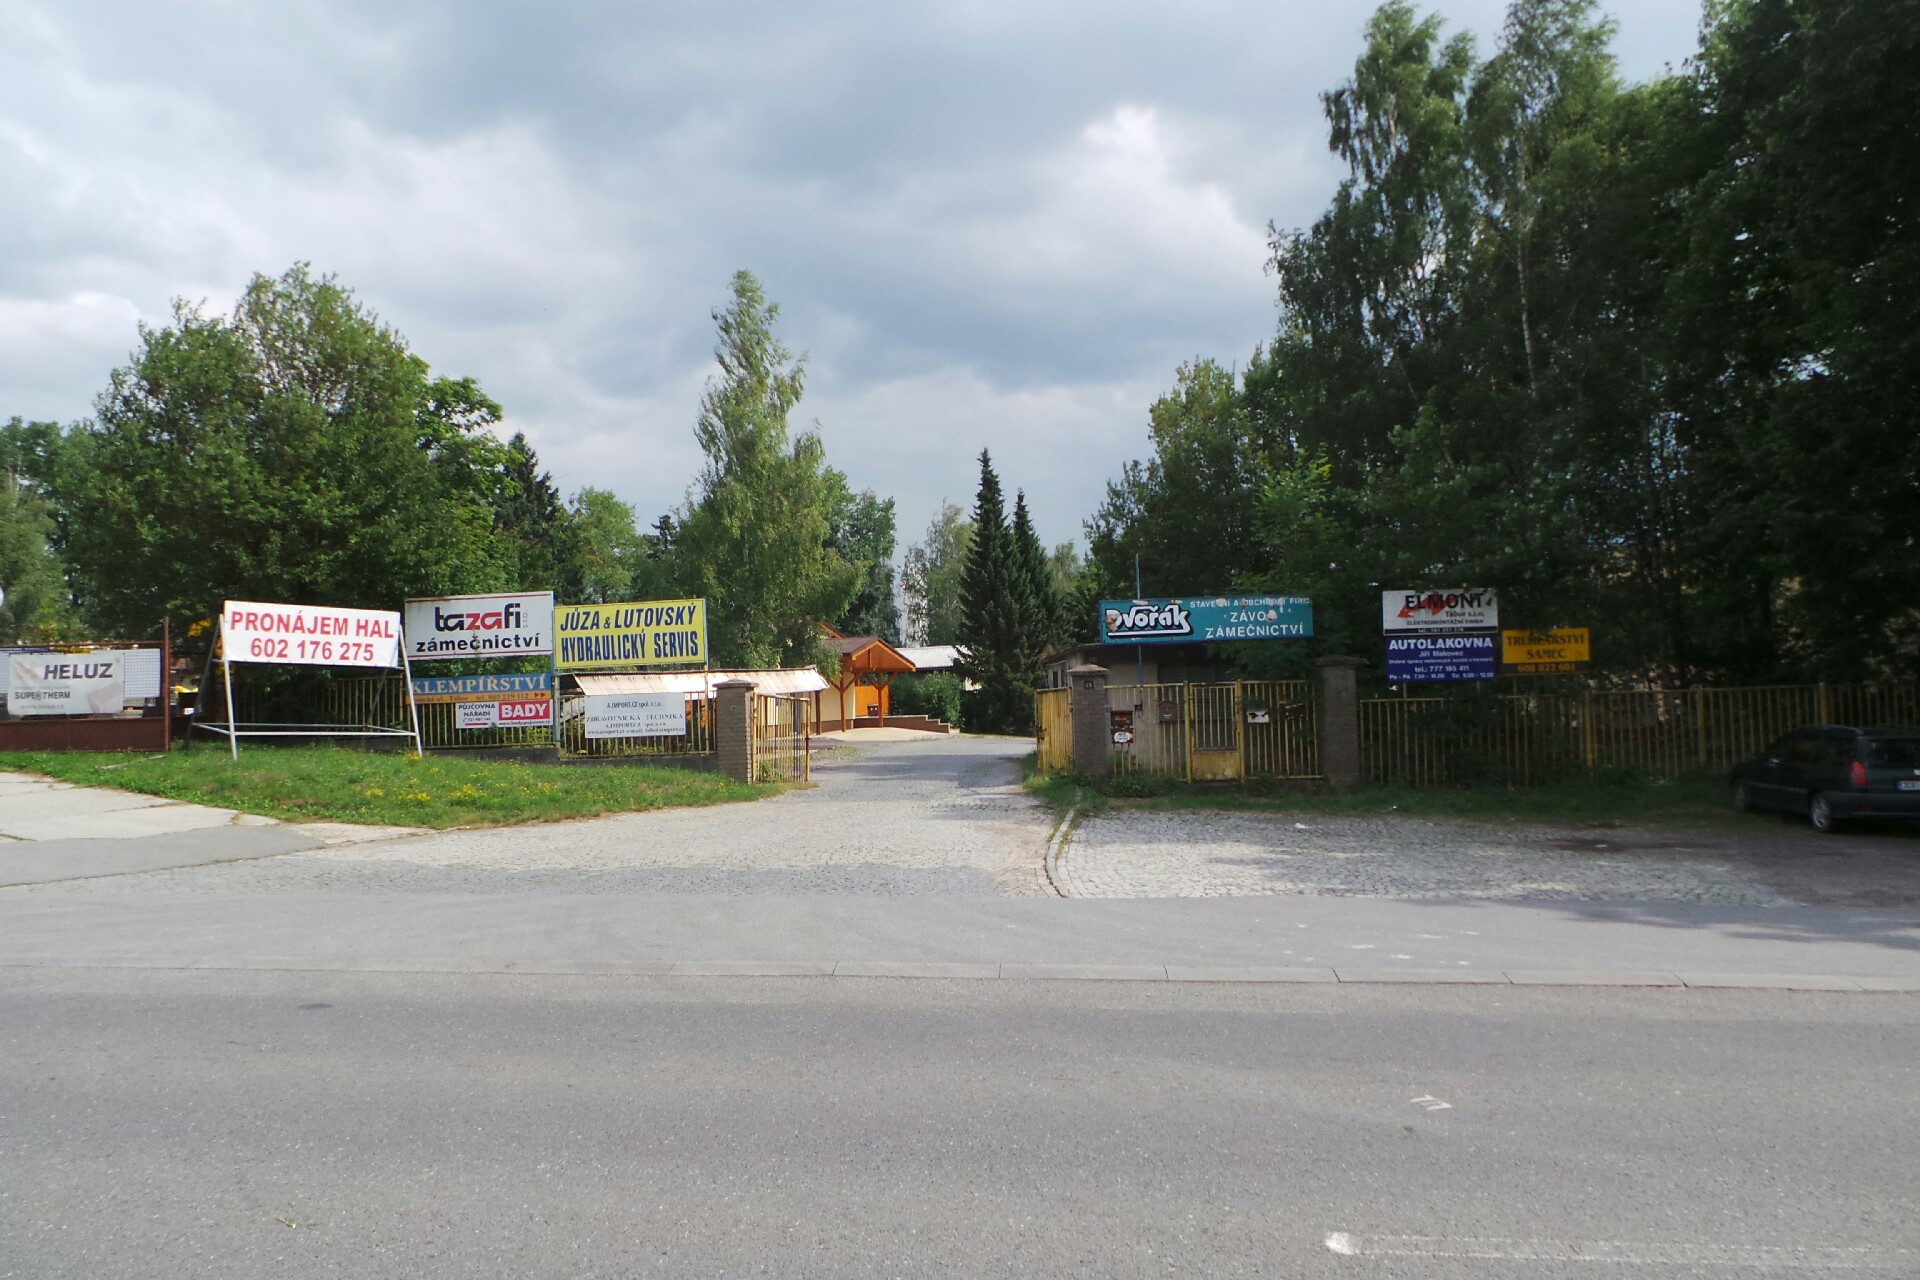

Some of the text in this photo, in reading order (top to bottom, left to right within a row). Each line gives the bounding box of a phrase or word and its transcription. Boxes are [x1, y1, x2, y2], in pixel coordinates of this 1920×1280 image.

[230, 609, 395, 639] PRONÁJEM HAL
[434, 602, 521, 632] tazafi
[560, 602, 696, 631] JŮZA & LUTOVSKÝ
[1105, 604, 1191, 636] Dvořák
[1229, 609, 1278, 623] ZÁVO
[1205, 622, 1304, 639] ZÁMEČNICTVÍ
[250, 637, 374, 662] 602 176 275
[416, 633, 541, 652] zámečnictví
[561, 628, 699, 662] HYDRAULICKÝ SERVIS
[1389, 637, 1493, 650] AUTOLAKOVNA
[1527, 648, 1565, 659] SAMEC
[43, 662, 114, 680] HELUZ
[411, 674, 546, 694] KLEMPÍŘSTVÍ
[458, 703, 497, 712] PŮJČOVNA
[501, 706, 548, 719] BADY
